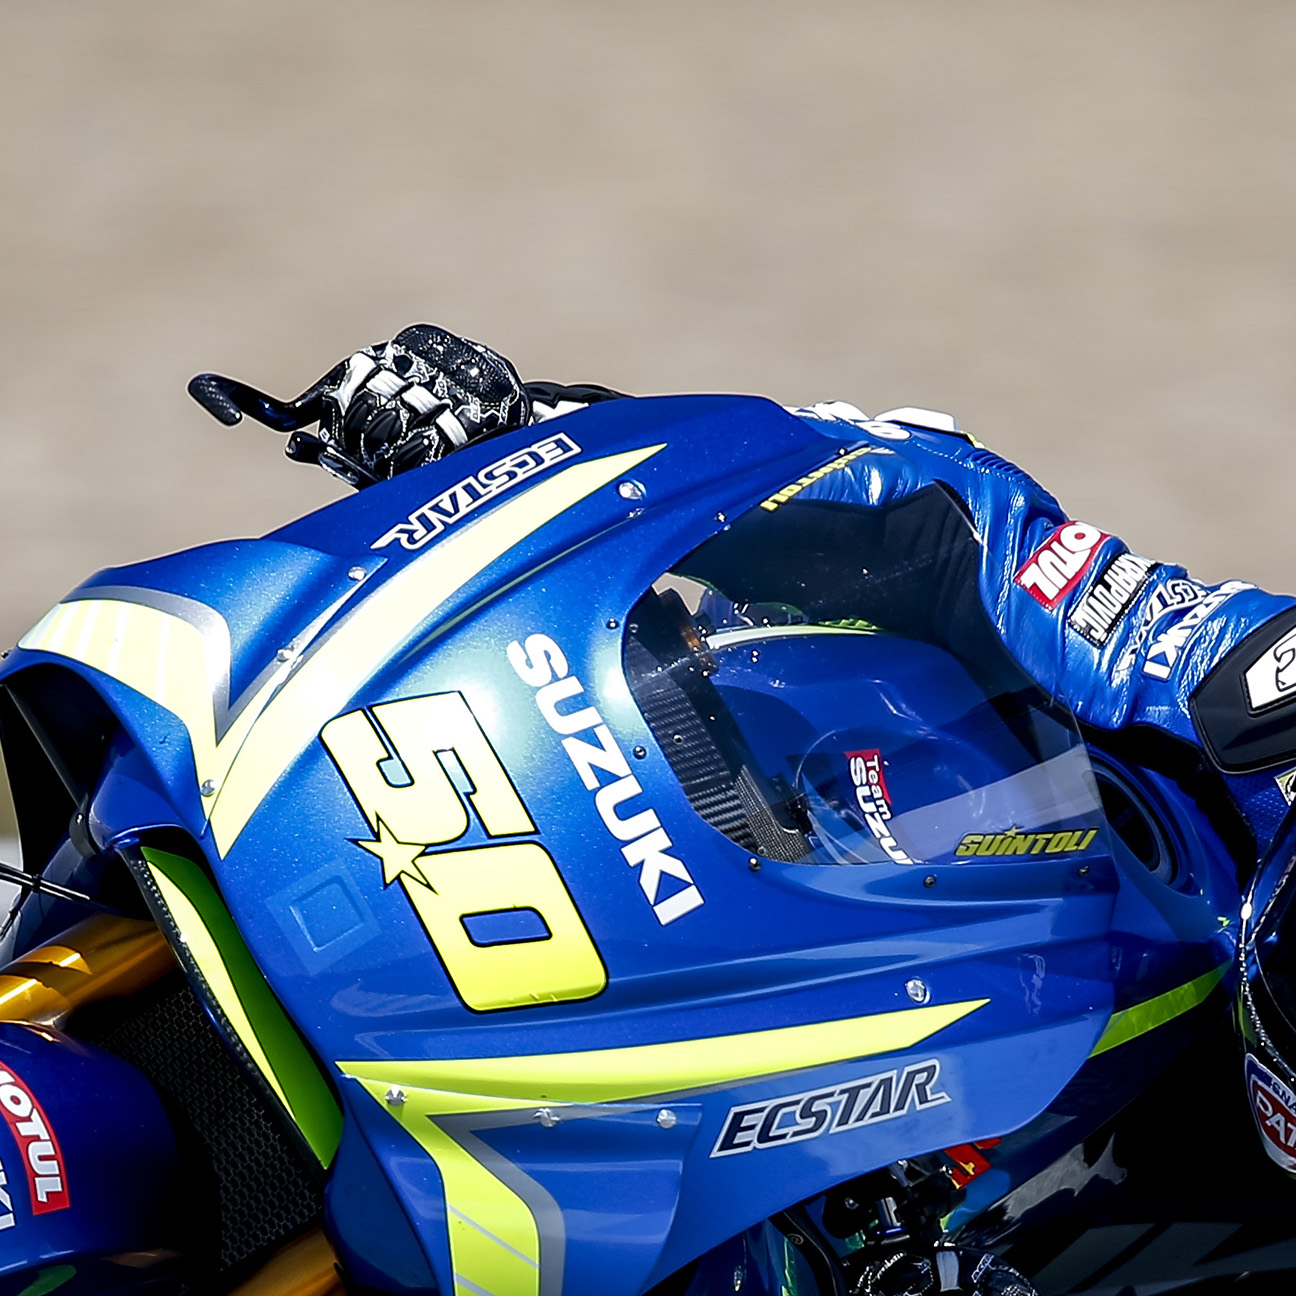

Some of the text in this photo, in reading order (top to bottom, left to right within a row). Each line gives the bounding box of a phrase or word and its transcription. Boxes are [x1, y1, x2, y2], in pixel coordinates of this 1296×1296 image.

[370, 432, 582, 550] ECSTAR
[1021, 522, 1102, 600] OTUL
[505, 633, 704, 925] SUZUKI
[849, 756, 915, 865] SUZU
[866, 755, 892, 820] Team
[318, 690, 607, 1014] 50
[709, 1058, 951, 1158] ECSTAR
